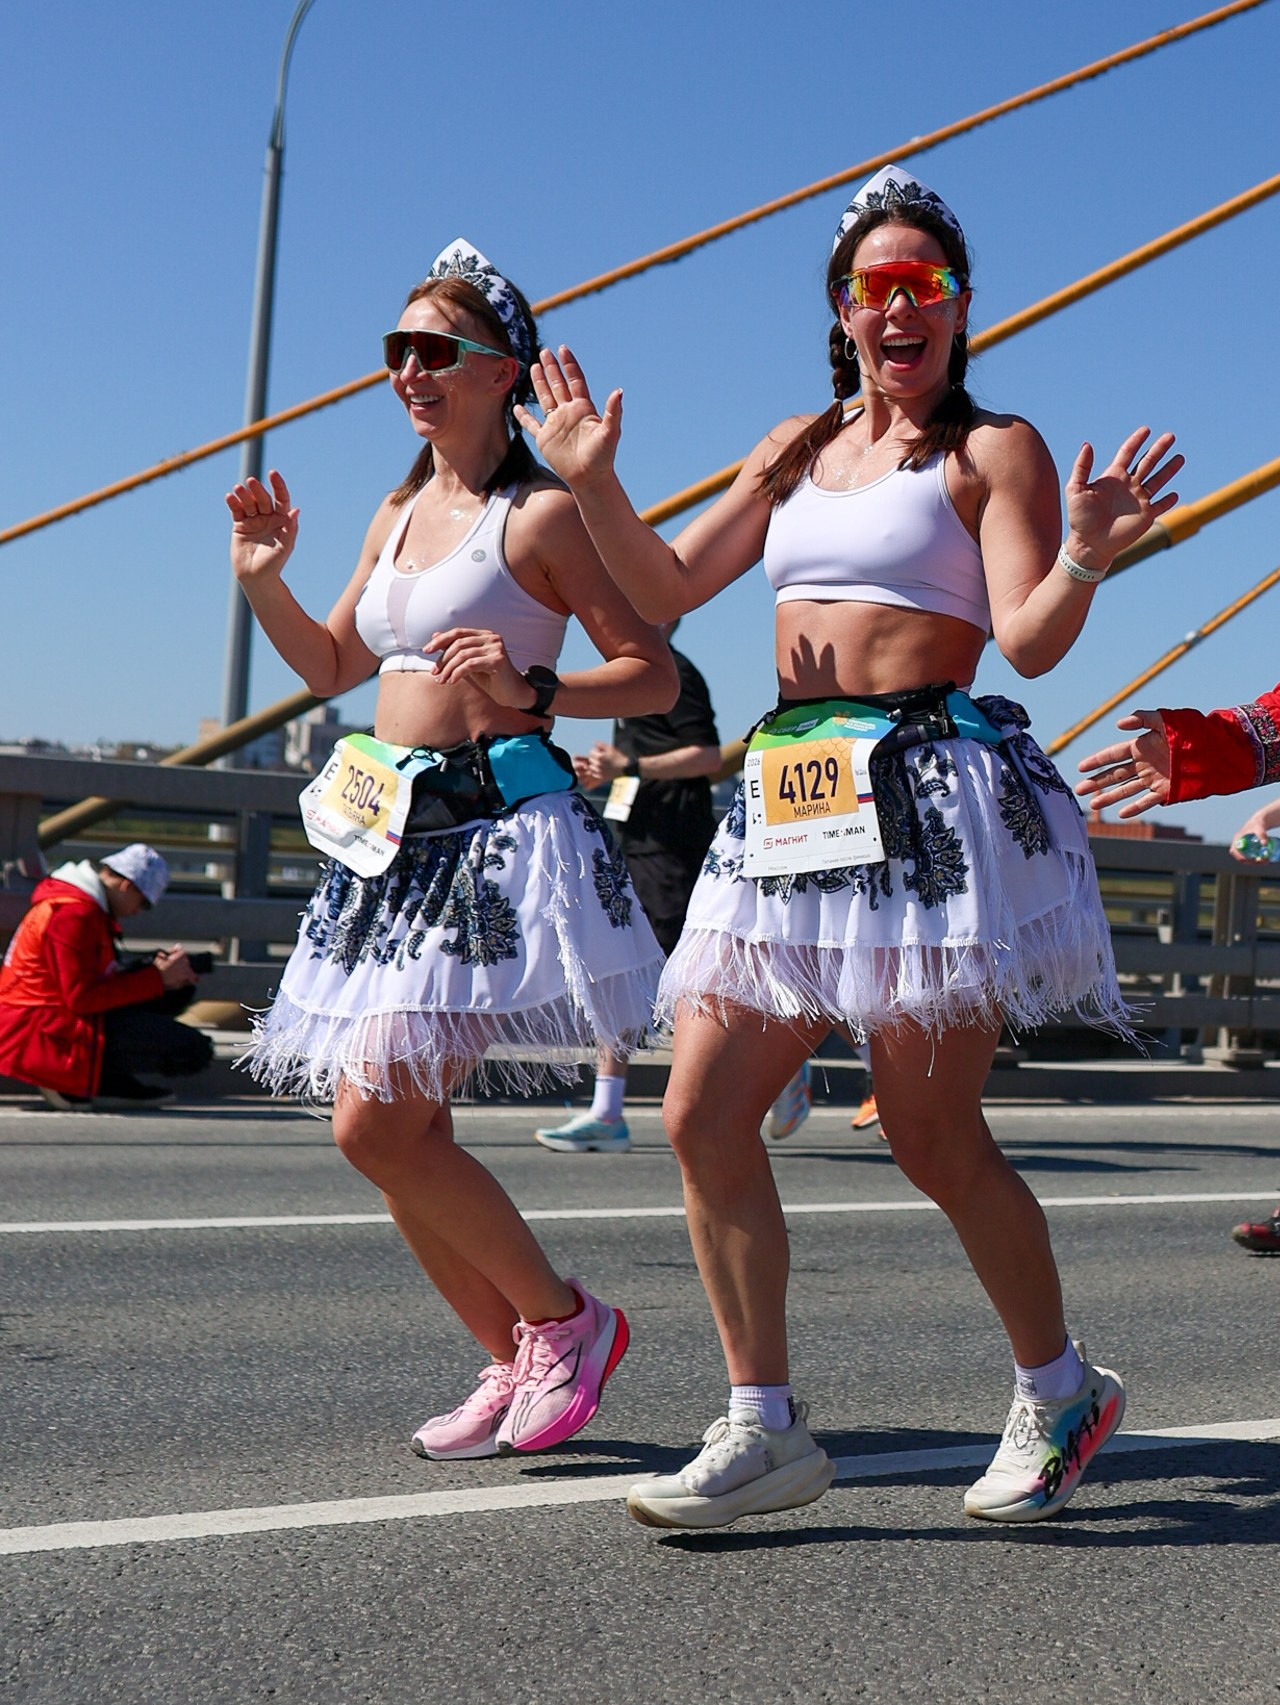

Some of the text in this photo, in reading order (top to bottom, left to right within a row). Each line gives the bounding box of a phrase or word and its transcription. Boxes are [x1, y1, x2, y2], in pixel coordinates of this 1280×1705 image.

[750, 780, 761, 798] E
[779, 757, 839, 804] 4129
[341, 765, 384, 817] 2504
[793, 802, 831, 819] МАРИНА
[775, 834, 809, 846] МАГНИТ
